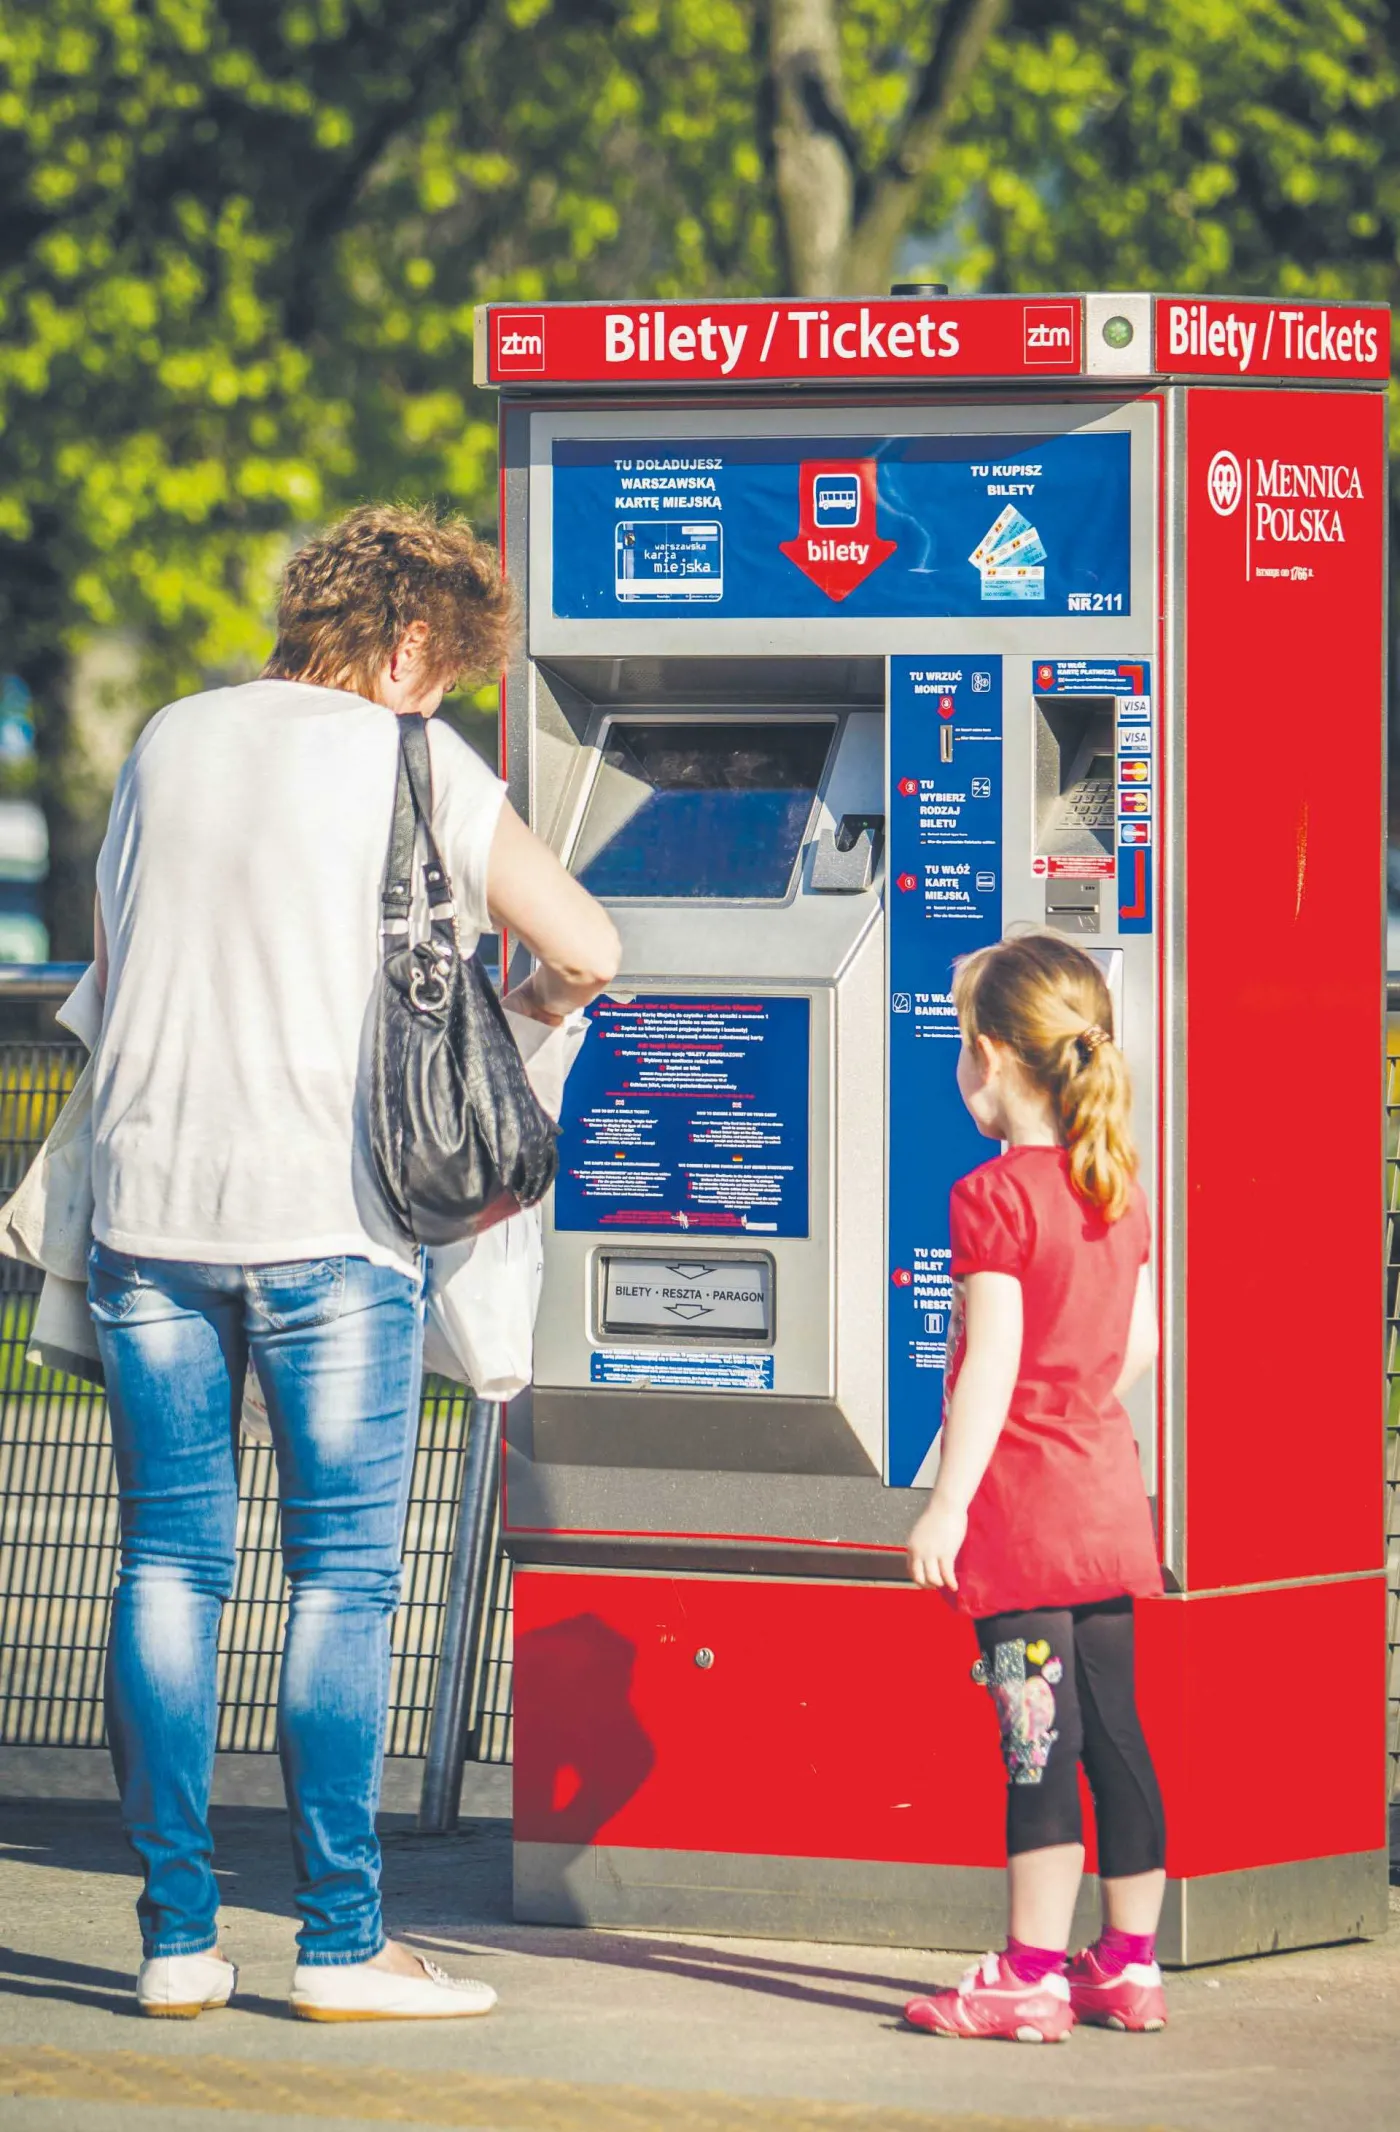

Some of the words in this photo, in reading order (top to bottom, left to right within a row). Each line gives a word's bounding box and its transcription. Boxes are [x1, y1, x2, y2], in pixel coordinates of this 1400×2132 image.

[605, 311, 748, 375] Bilety
[759, 311, 779, 363] /
[788, 308, 960, 359] Tickets
[1027, 324, 1070, 347] ztm
[1169, 305, 1256, 372] Bilety
[1262, 310, 1275, 361] /
[1279, 311, 1378, 363] Tickets
[501, 332, 542, 354] ztm
[614, 459, 632, 471] TU
[636, 459, 723, 471] DOŁADUJESZ
[970, 466, 988, 477] TU
[992, 465, 1042, 477] KUPISZ
[621, 477, 716, 491] WARSZAWSKĄ
[1256, 459, 1364, 499] MENNICA
[987, 484, 1035, 496] BILETY
[615, 498, 659, 511] KARTĘ
[662, 498, 722, 511] MIEJSKĄ
[1255, 503, 1346, 542] POLSKA
[654, 542, 707, 551] warszawska
[807, 540, 869, 565] bilety
[644, 550, 676, 560] karta
[654, 558, 711, 576] miejska
[909, 672, 923, 682] TU
[926, 670, 963, 682] WRZUĆ
[914, 685, 957, 694] MONETY
[1124, 702, 1147, 711] VISA
[1125, 733, 1148, 743] VISA
[920, 780, 934, 789] TU
[920, 793, 966, 802] WYBIERZ
[920, 806, 960, 815] RODZAJ
[920, 819, 956, 828] BILETU
[925, 865, 939, 874] TU
[941, 863, 970, 875] WŁÓŻ
[925, 878, 959, 890] KARTĘ
[925, 891, 970, 902] MIEJSKĄ
[915, 993, 929, 1003] TU
[915, 1006, 958, 1017] BANKNO
[914, 1248, 928, 1258] TU
[930, 1248, 952, 1259] ODB
[914, 1261, 943, 1271] BILET
[914, 1274, 953, 1283] PAPIER
[616, 1286, 651, 1297] BILETY
[662, 1288, 702, 1299] RESZTA
[713, 1291, 764, 1302] PARAGON
[920, 1300, 952, 1310] RESZT
